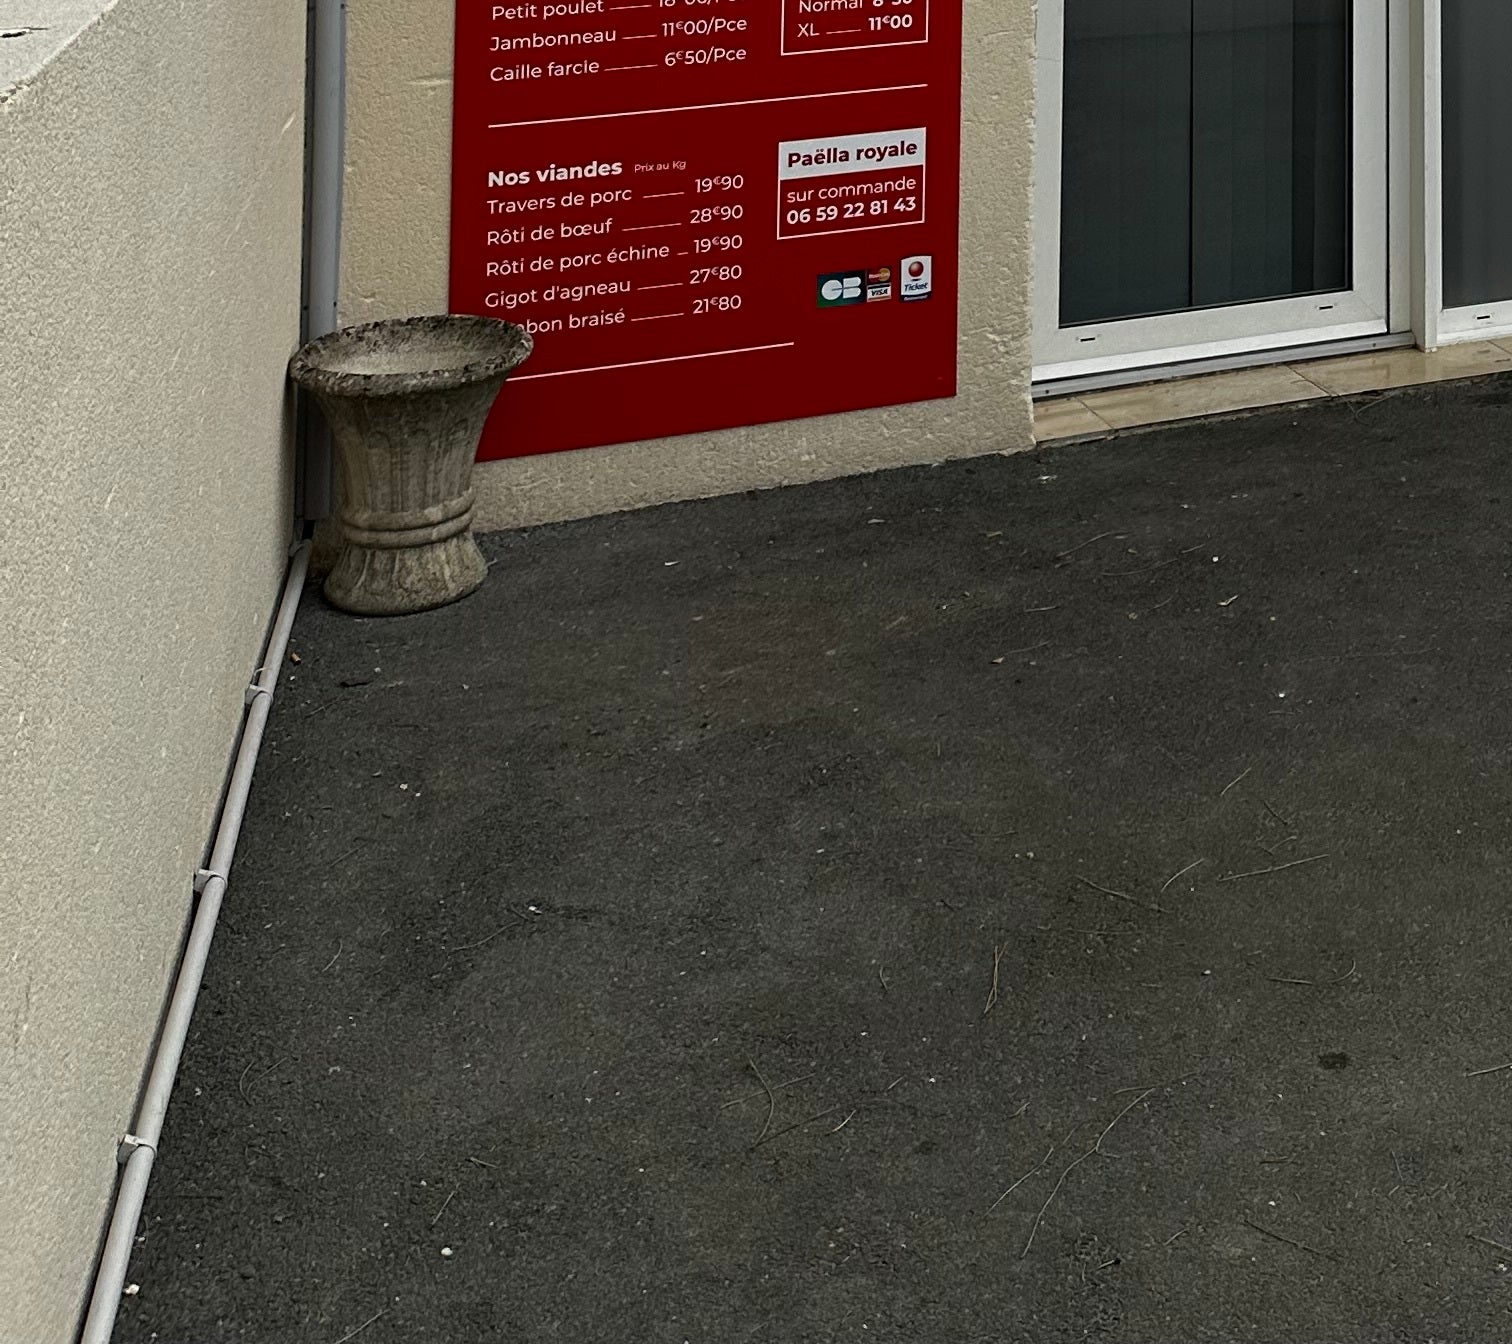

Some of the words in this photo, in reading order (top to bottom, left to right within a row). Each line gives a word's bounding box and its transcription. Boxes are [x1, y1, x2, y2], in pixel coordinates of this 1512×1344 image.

[492, 2, 538, 21] Petit
[489, 30, 617, 52] Jambonneau
[797, 22, 820, 38] XL
[489, 63, 543, 82] Caille
[546, 59, 600, 77] farcie
[787, 146, 851, 168] Paëlla
[856, 139, 918, 164] royale
[488, 170, 531, 188] Nos
[535, 160, 623, 183] viandes
[634, 162, 655, 174] Prix
[656, 162, 670, 171] au
[672, 160, 687, 171] Kg
[486, 197, 556, 215] Travers
[560, 191, 585, 207] de
[590, 189, 632, 208] porc
[786, 189, 815, 204] sur
[818, 175, 917, 200] commande
[786, 208, 811, 225] 06
[815, 205, 839, 222] 59
[843, 202, 865, 219] 22
[869, 199, 888, 216] 81
[893, 196, 917, 212] 43
[487, 226, 525, 246] Rôti
[530, 225, 555, 241] de
[560, 217, 613, 238] bœuf
[486, 257, 525, 277] Rôti
[529, 255, 554, 272] de
[559, 253, 602, 273] porc
[606, 244, 670, 264] échine
[484, 289, 538, 310] Gigot
[542, 280, 631, 302] d'agneau
[568, 307, 626, 329] braisé
